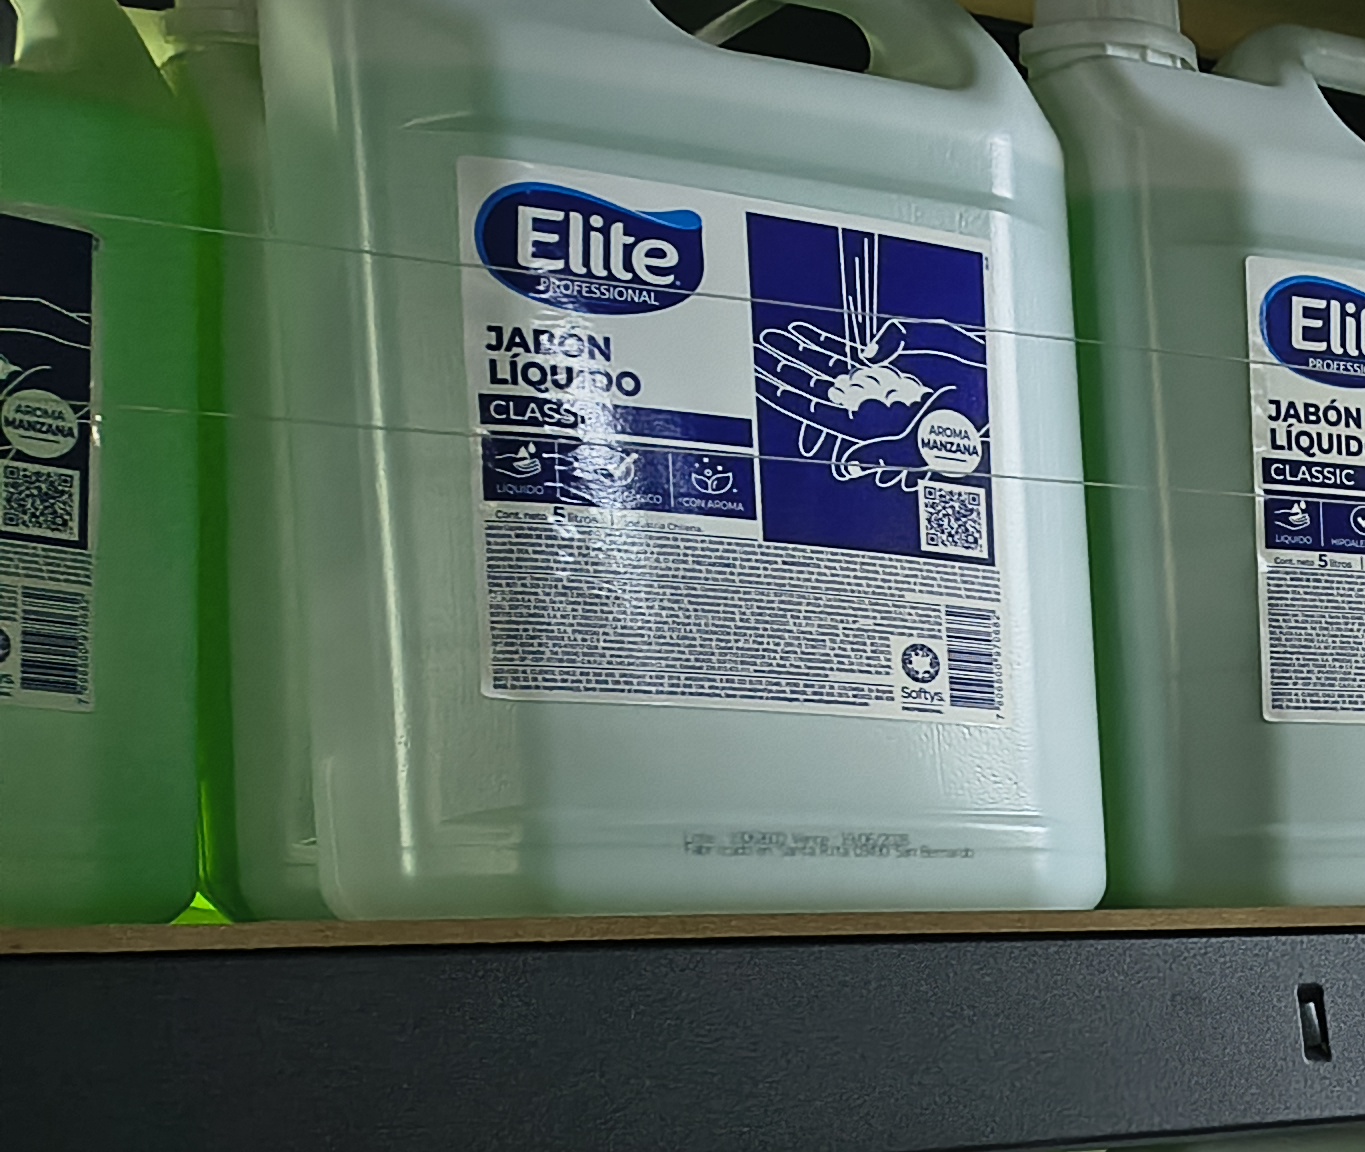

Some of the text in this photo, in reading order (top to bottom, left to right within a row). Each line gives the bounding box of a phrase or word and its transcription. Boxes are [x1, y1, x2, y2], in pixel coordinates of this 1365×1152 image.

[516, 205, 679, 286] Elite
[538, 277, 660, 306] PROFESSIONAL
[15, 402, 65, 421] AROMA
[1268, 399, 1362, 429] JABÓN
[3, 416, 75, 439] MANZANA
[929, 424, 971, 441] AROMA
[921, 438, 980, 457] MANZANA
[1271, 463, 1355, 485] CLASSIC
[553, 506, 566, 523] 5
[1318, 553, 1328, 568] 5
